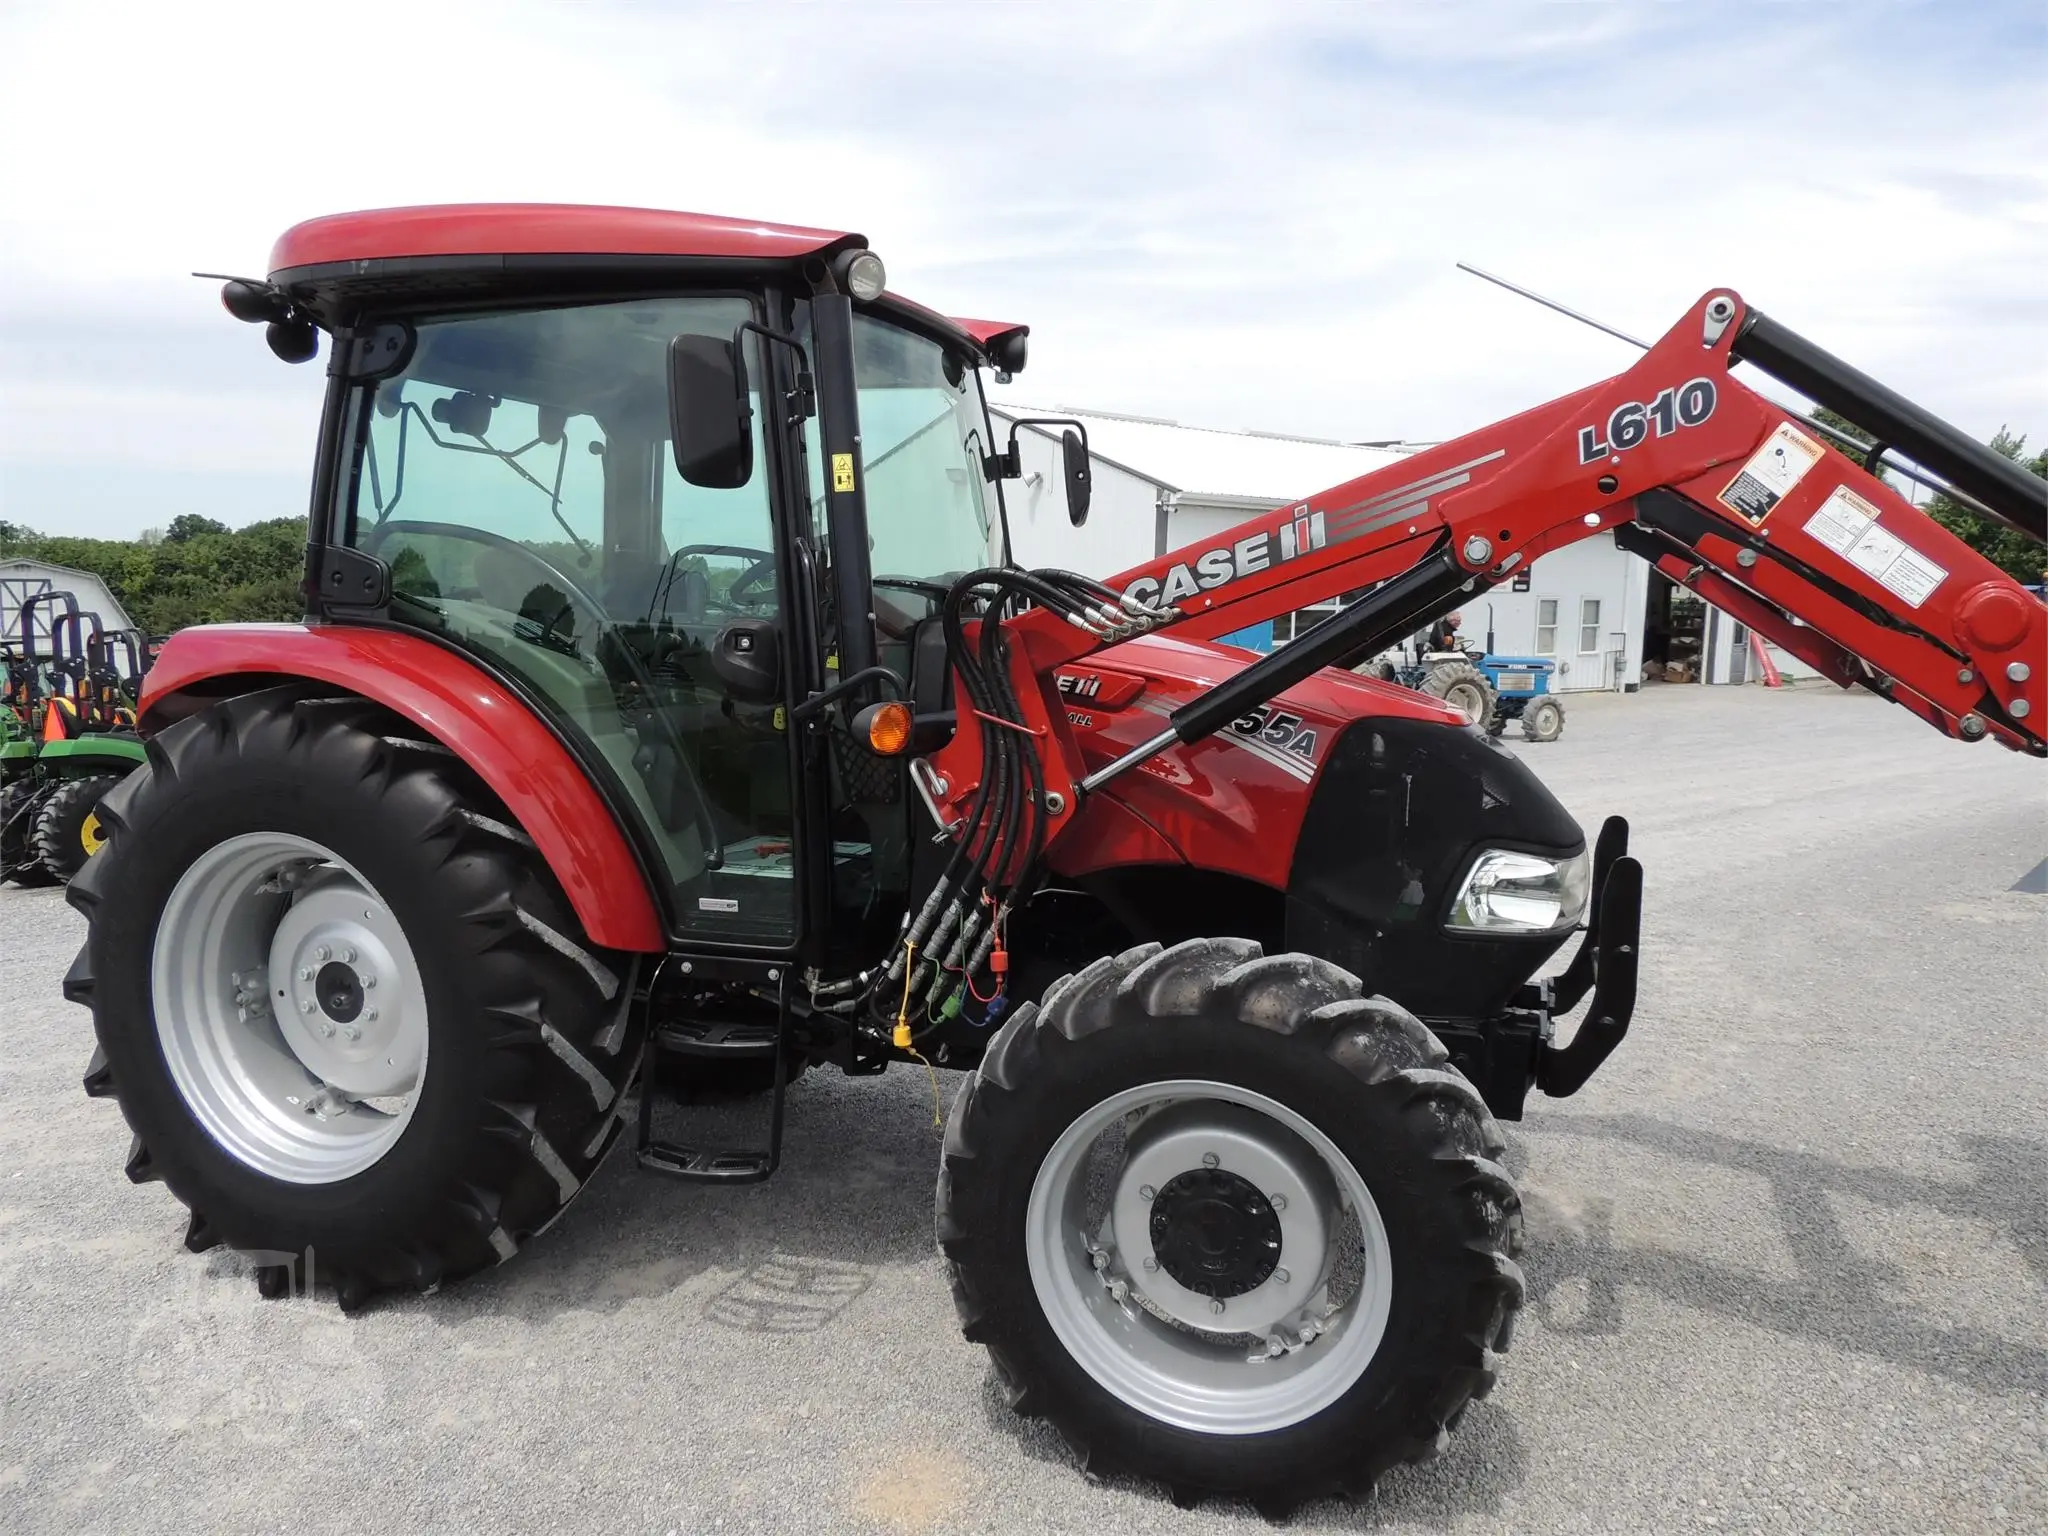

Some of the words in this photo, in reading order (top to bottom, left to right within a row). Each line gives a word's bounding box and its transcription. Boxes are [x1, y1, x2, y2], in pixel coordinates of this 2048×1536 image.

[1578, 377, 1718, 465] L610
[1789, 434, 1818, 457] WARNING
[1120, 532, 1271, 615] CASE
[1067, 711, 1093, 728] ALL
